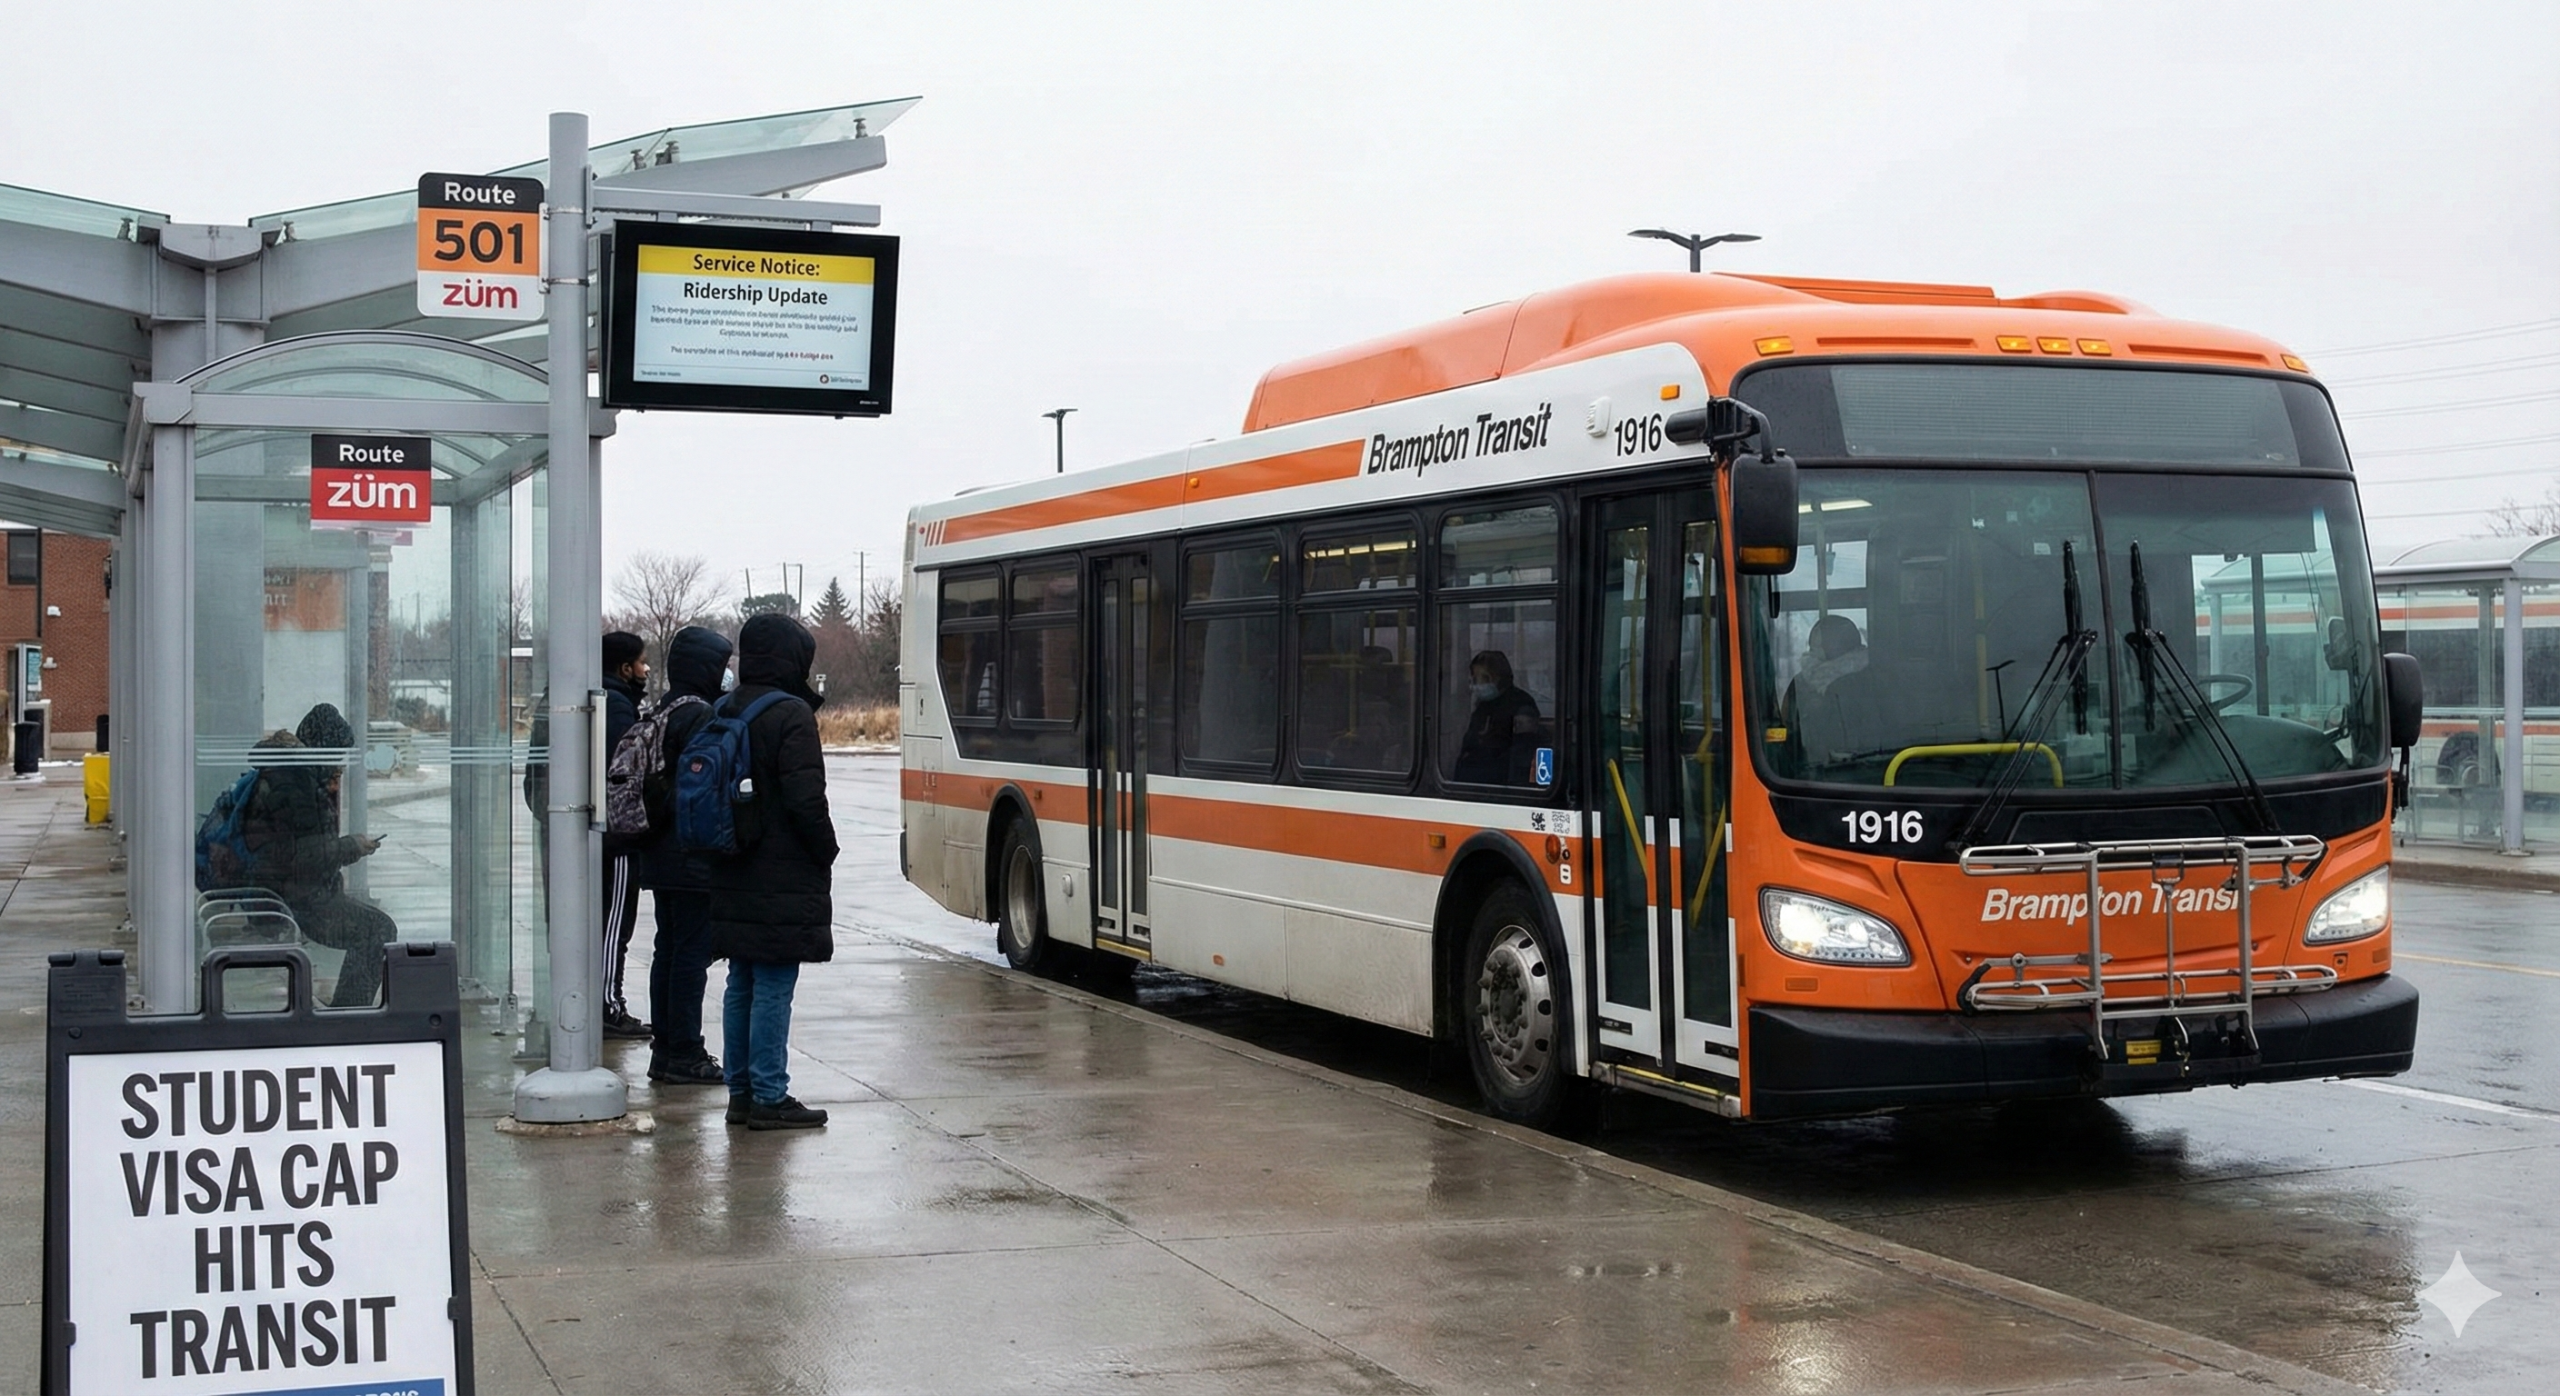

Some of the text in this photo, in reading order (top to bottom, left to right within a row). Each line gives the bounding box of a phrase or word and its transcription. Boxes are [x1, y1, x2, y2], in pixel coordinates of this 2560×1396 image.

[444, 181, 516, 204] Route
[434, 219, 523, 264] 501
[693, 254, 820, 276] Service Notice:
[443, 278, 518, 309] züm
[684, 282, 828, 307] Ridership Update
[1367, 402, 1552, 478] Brampton Transit
[1614, 413, 1662, 456] 1916
[339, 444, 405, 463] Route
[327, 473, 417, 509] züm
[1841, 810, 1924, 843] 1916
[2151, 882, 2239, 914] Transi
[120, 1064, 396, 1140] STUDENT
[120, 1141, 400, 1217] VISA CAP
[194, 1220, 335, 1294] HITS
[130, 1296, 396, 1379] TRANSIT
